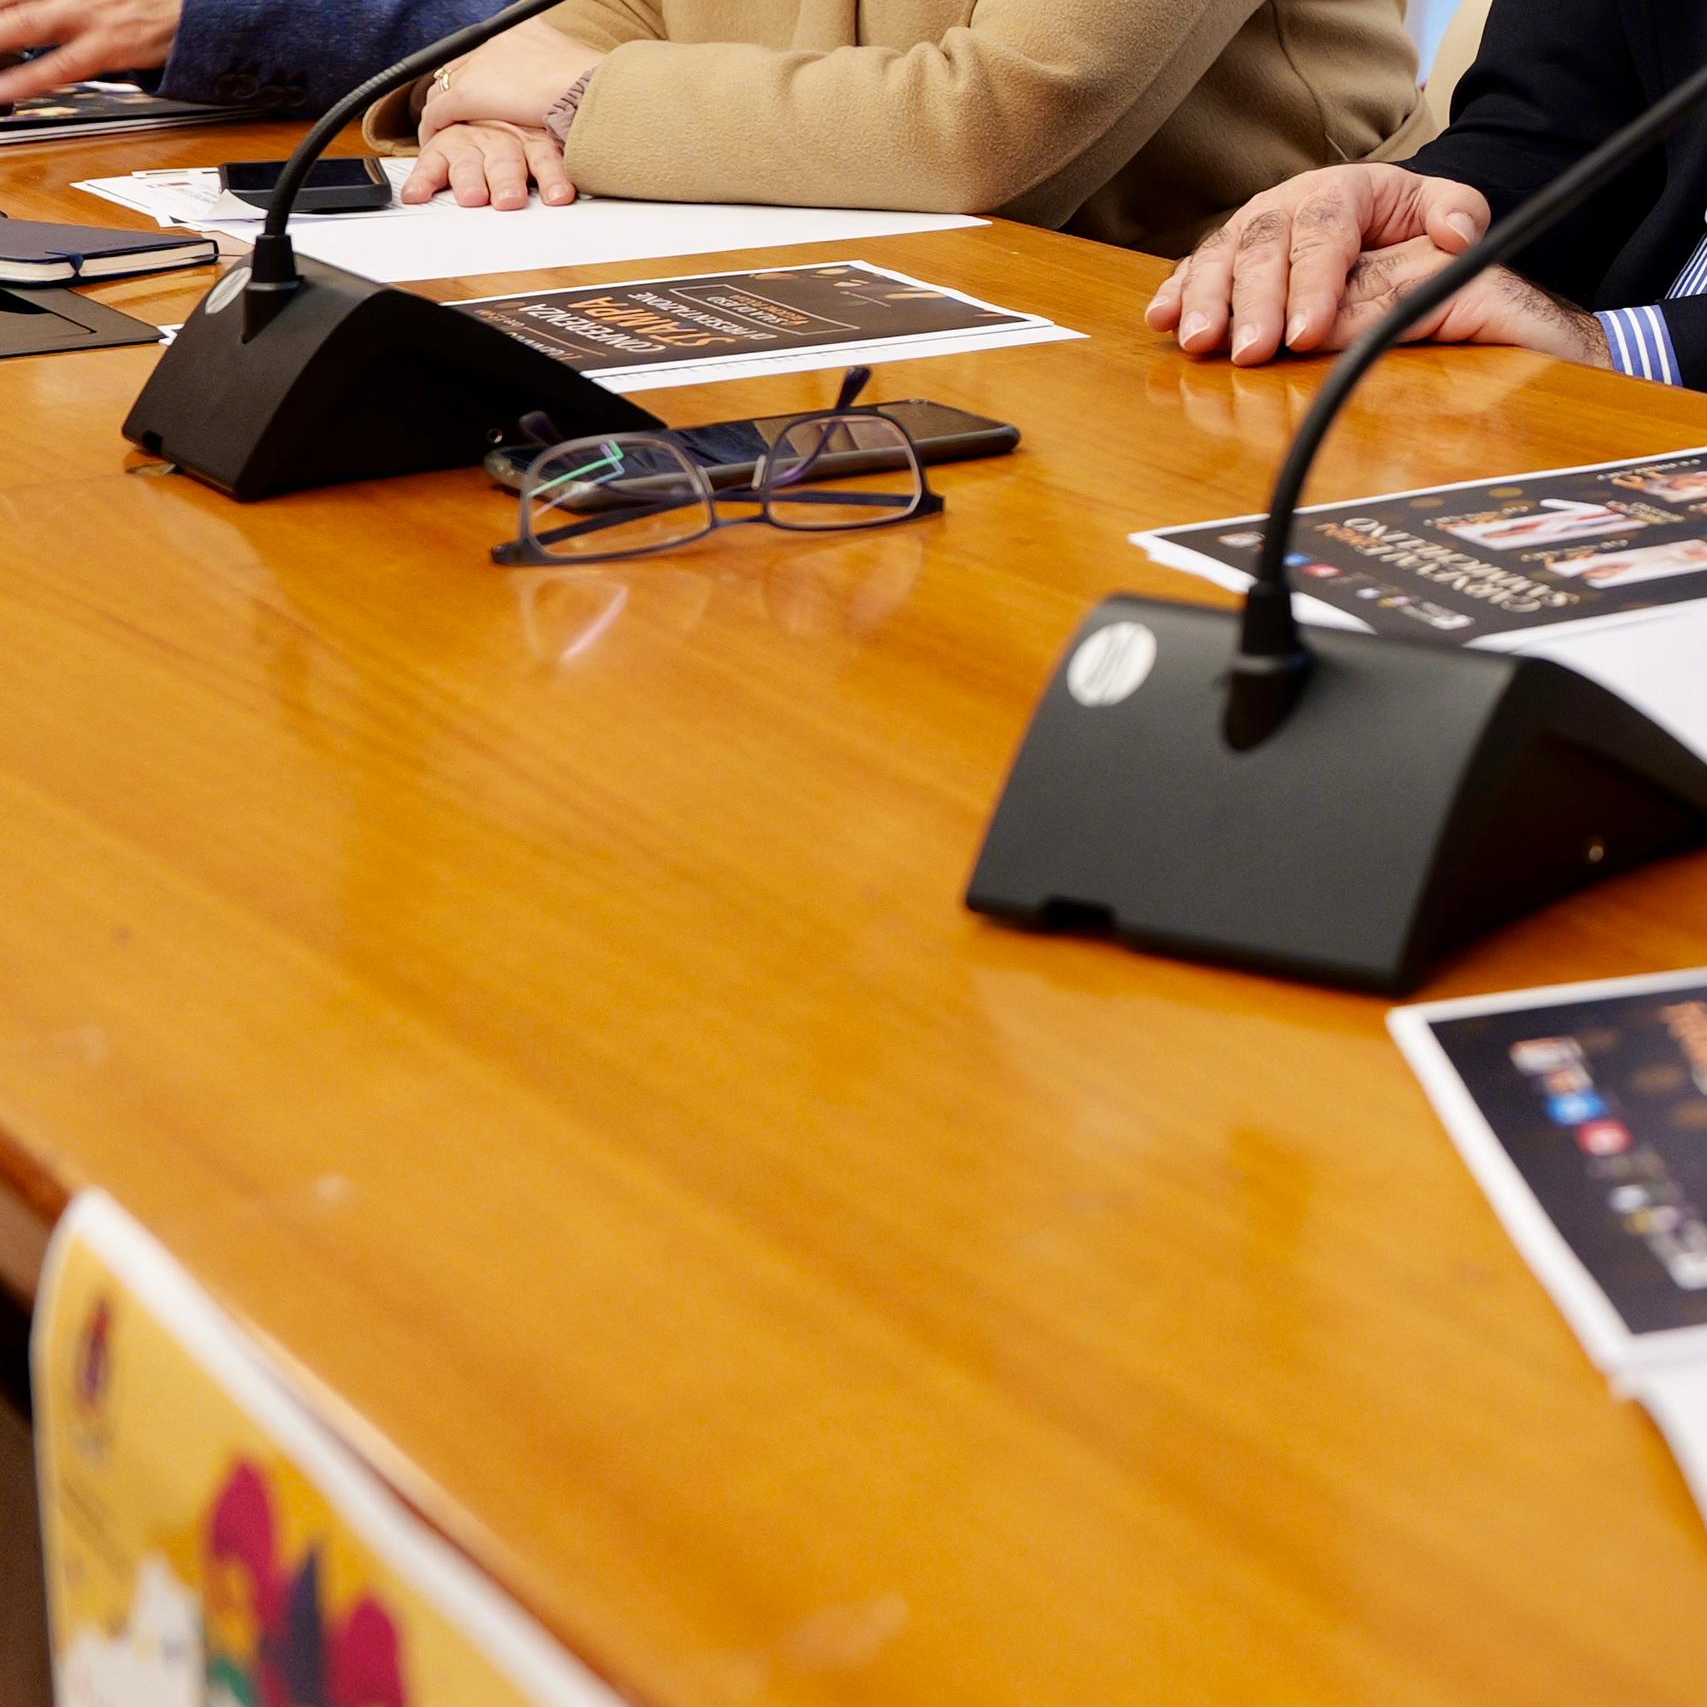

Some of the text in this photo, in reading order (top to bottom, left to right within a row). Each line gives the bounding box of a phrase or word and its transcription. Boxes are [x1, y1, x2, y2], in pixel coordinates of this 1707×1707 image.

[516, 303, 667, 353] CONFERENZA
[566, 296, 737, 347] STAMPA
[626, 291, 758, 336] PRESENTAZIONE
